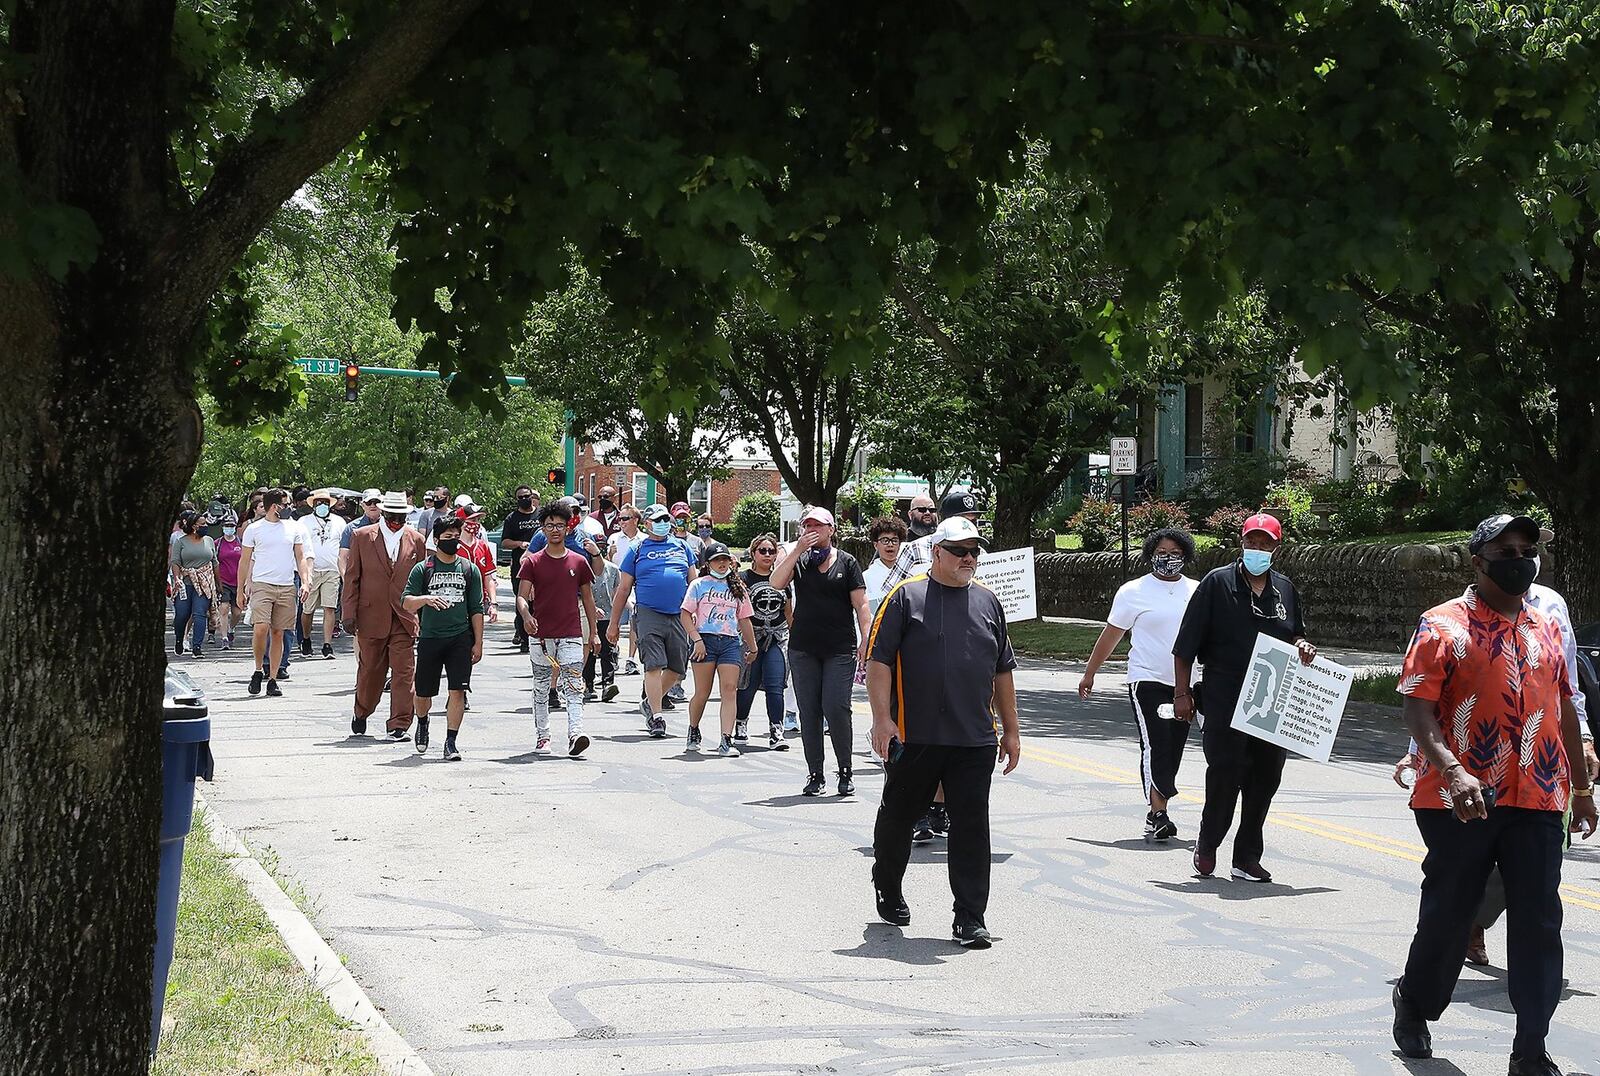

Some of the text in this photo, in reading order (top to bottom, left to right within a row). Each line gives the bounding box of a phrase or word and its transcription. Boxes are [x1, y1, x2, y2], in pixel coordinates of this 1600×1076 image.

[317, 361, 326, 372] St
[976, 554, 1026, 567] Genesis 1:27
[1000, 569, 1025, 577] created
[703, 605, 735, 624] fear
[1246, 671, 1260, 701] WE ARE
[1275, 655, 1299, 713] SIMUNYE
[1333, 671, 1347, 682] 1:27
[1292, 685, 1334, 706] man in his own
[1306, 680, 1319, 691] God
[1319, 686, 1340, 699] created
[1291, 694, 1308, 706] image,
[1315, 703, 1325, 712] the
[1288, 701, 1305, 714] image
[1312, 711, 1325, 722] God
[1324, 716, 1332, 725] he
[1282, 720, 1320, 739] and female he
[1285, 711, 1306, 724] created
[1319, 725, 1333, 735] male
[1280, 729, 1320, 748] created them."
